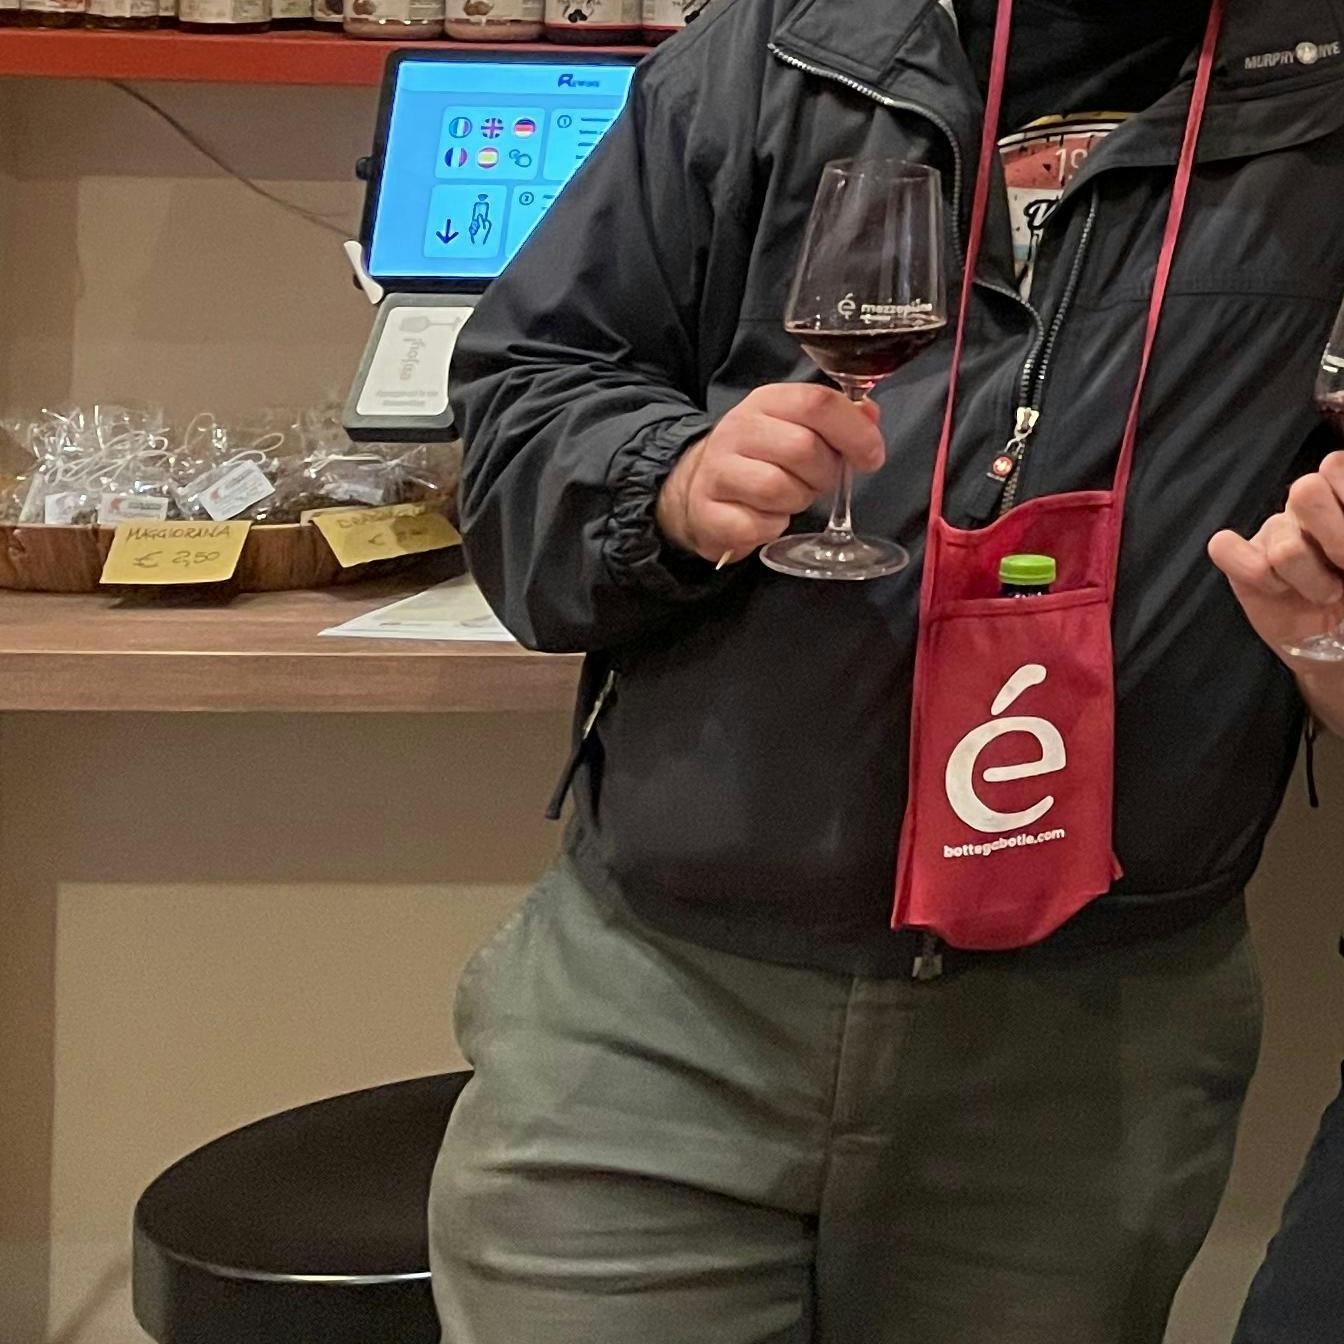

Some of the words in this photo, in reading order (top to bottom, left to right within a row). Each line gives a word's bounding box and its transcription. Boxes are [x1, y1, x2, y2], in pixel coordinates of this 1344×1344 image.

[1245, 51, 1294, 69] MURPHY
[127, 525, 231, 543] MAGGIORANA
[134, 551, 157, 568] €
[945, 664, 1067, 833] é
